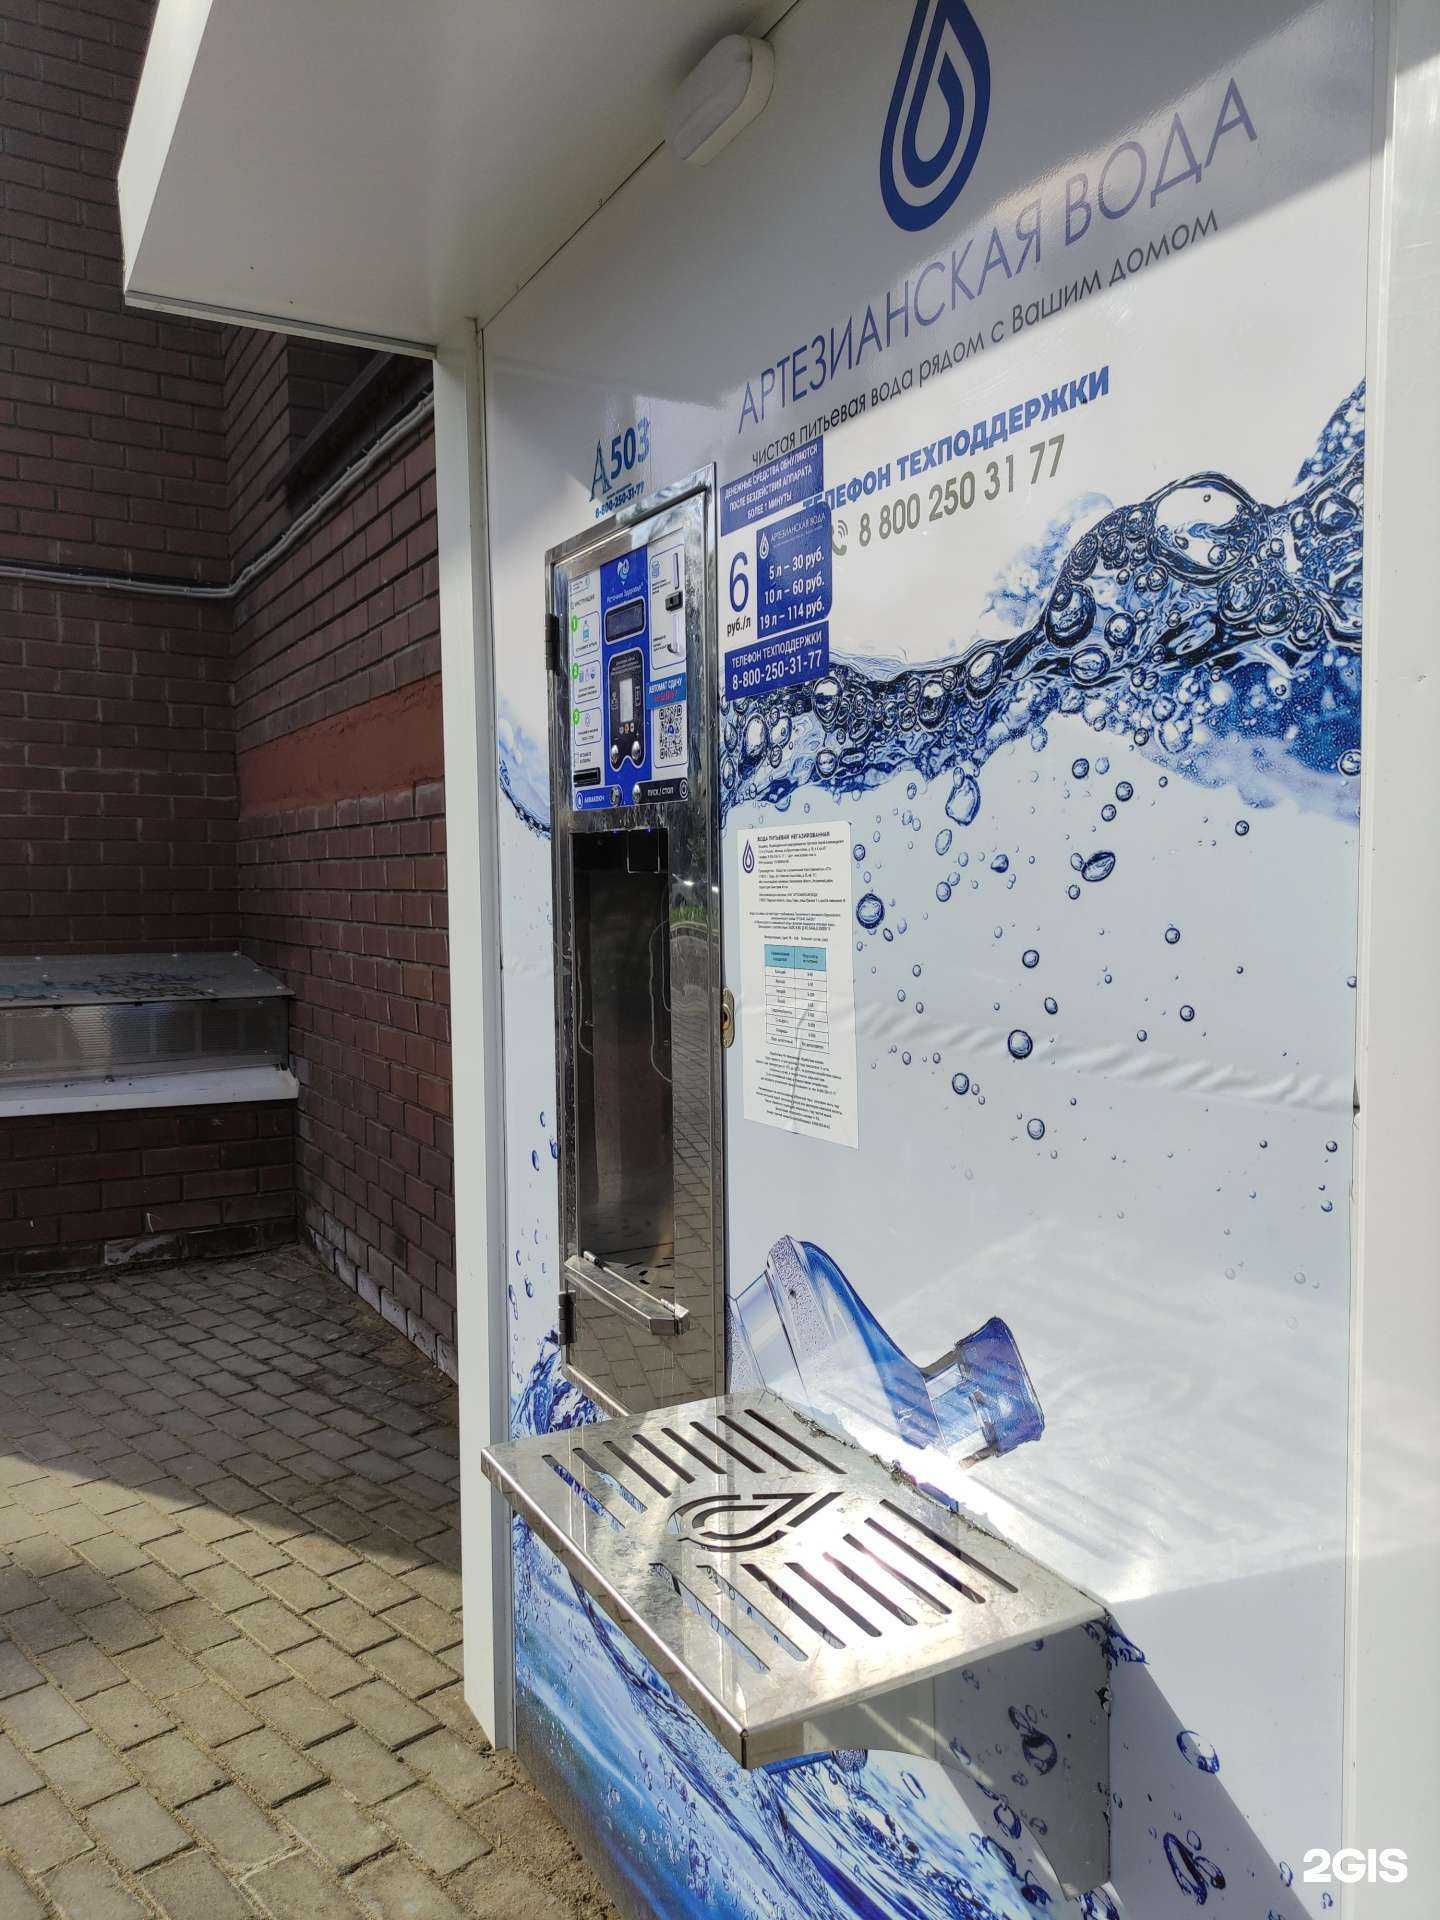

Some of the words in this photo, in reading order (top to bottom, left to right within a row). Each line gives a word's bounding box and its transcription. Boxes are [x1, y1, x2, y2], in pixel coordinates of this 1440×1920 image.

[738, 200, 1041, 434] АРТЕЗИАНСКАЯ
[1064, 77, 1257, 246] ВОДА
[752, 432, 796, 468] чистая
[800, 393, 866, 446] питьевая
[871, 368, 913, 406] вода
[919, 333, 984, 388] рядом
[991, 321, 1004, 343] с
[1012, 270, 1101, 333] Вашим
[1109, 209, 1218, 287] домом
[897, 366, 1110, 481] ТЕХПОДДЕРЖКИ
[725, 478, 752, 501] ДЕНЕЖНЫЕ
[752, 465, 780, 487] СРЕДСТВА
[729, 496, 746, 512] ПОСЛЕ
[783, 464, 813, 488] АППАРАТА
[859, 512, 871, 547] 8
[878, 493, 921, 540] 800
[928, 471, 976, 522] 250
[984, 453, 1014, 501] 31
[1029, 434, 1065, 485] 77
[747, 503, 764, 519] БОЛЕЕ
[768, 491, 792, 510] МИНУТЫ
[729, 551, 750, 613] 6
[769, 565, 775, 580] 5
[792, 554, 804, 571] 30
[805, 545, 825, 571] руб.
[764, 588, 775, 605] 10
[792, 578, 804, 596] 60
[805, 570, 825, 594] руб.
[727, 615, 751, 637] руб./л
[760, 614, 770, 630] 19
[787, 602, 804, 621] 114
[805, 595, 825, 619] руб.
[731, 650, 762, 669] ТЕЛЕФОН
[763, 630, 823, 659] ТЕХПОДДЕРЖКИ
[732, 648, 823, 691] 8-800-250-31-77
